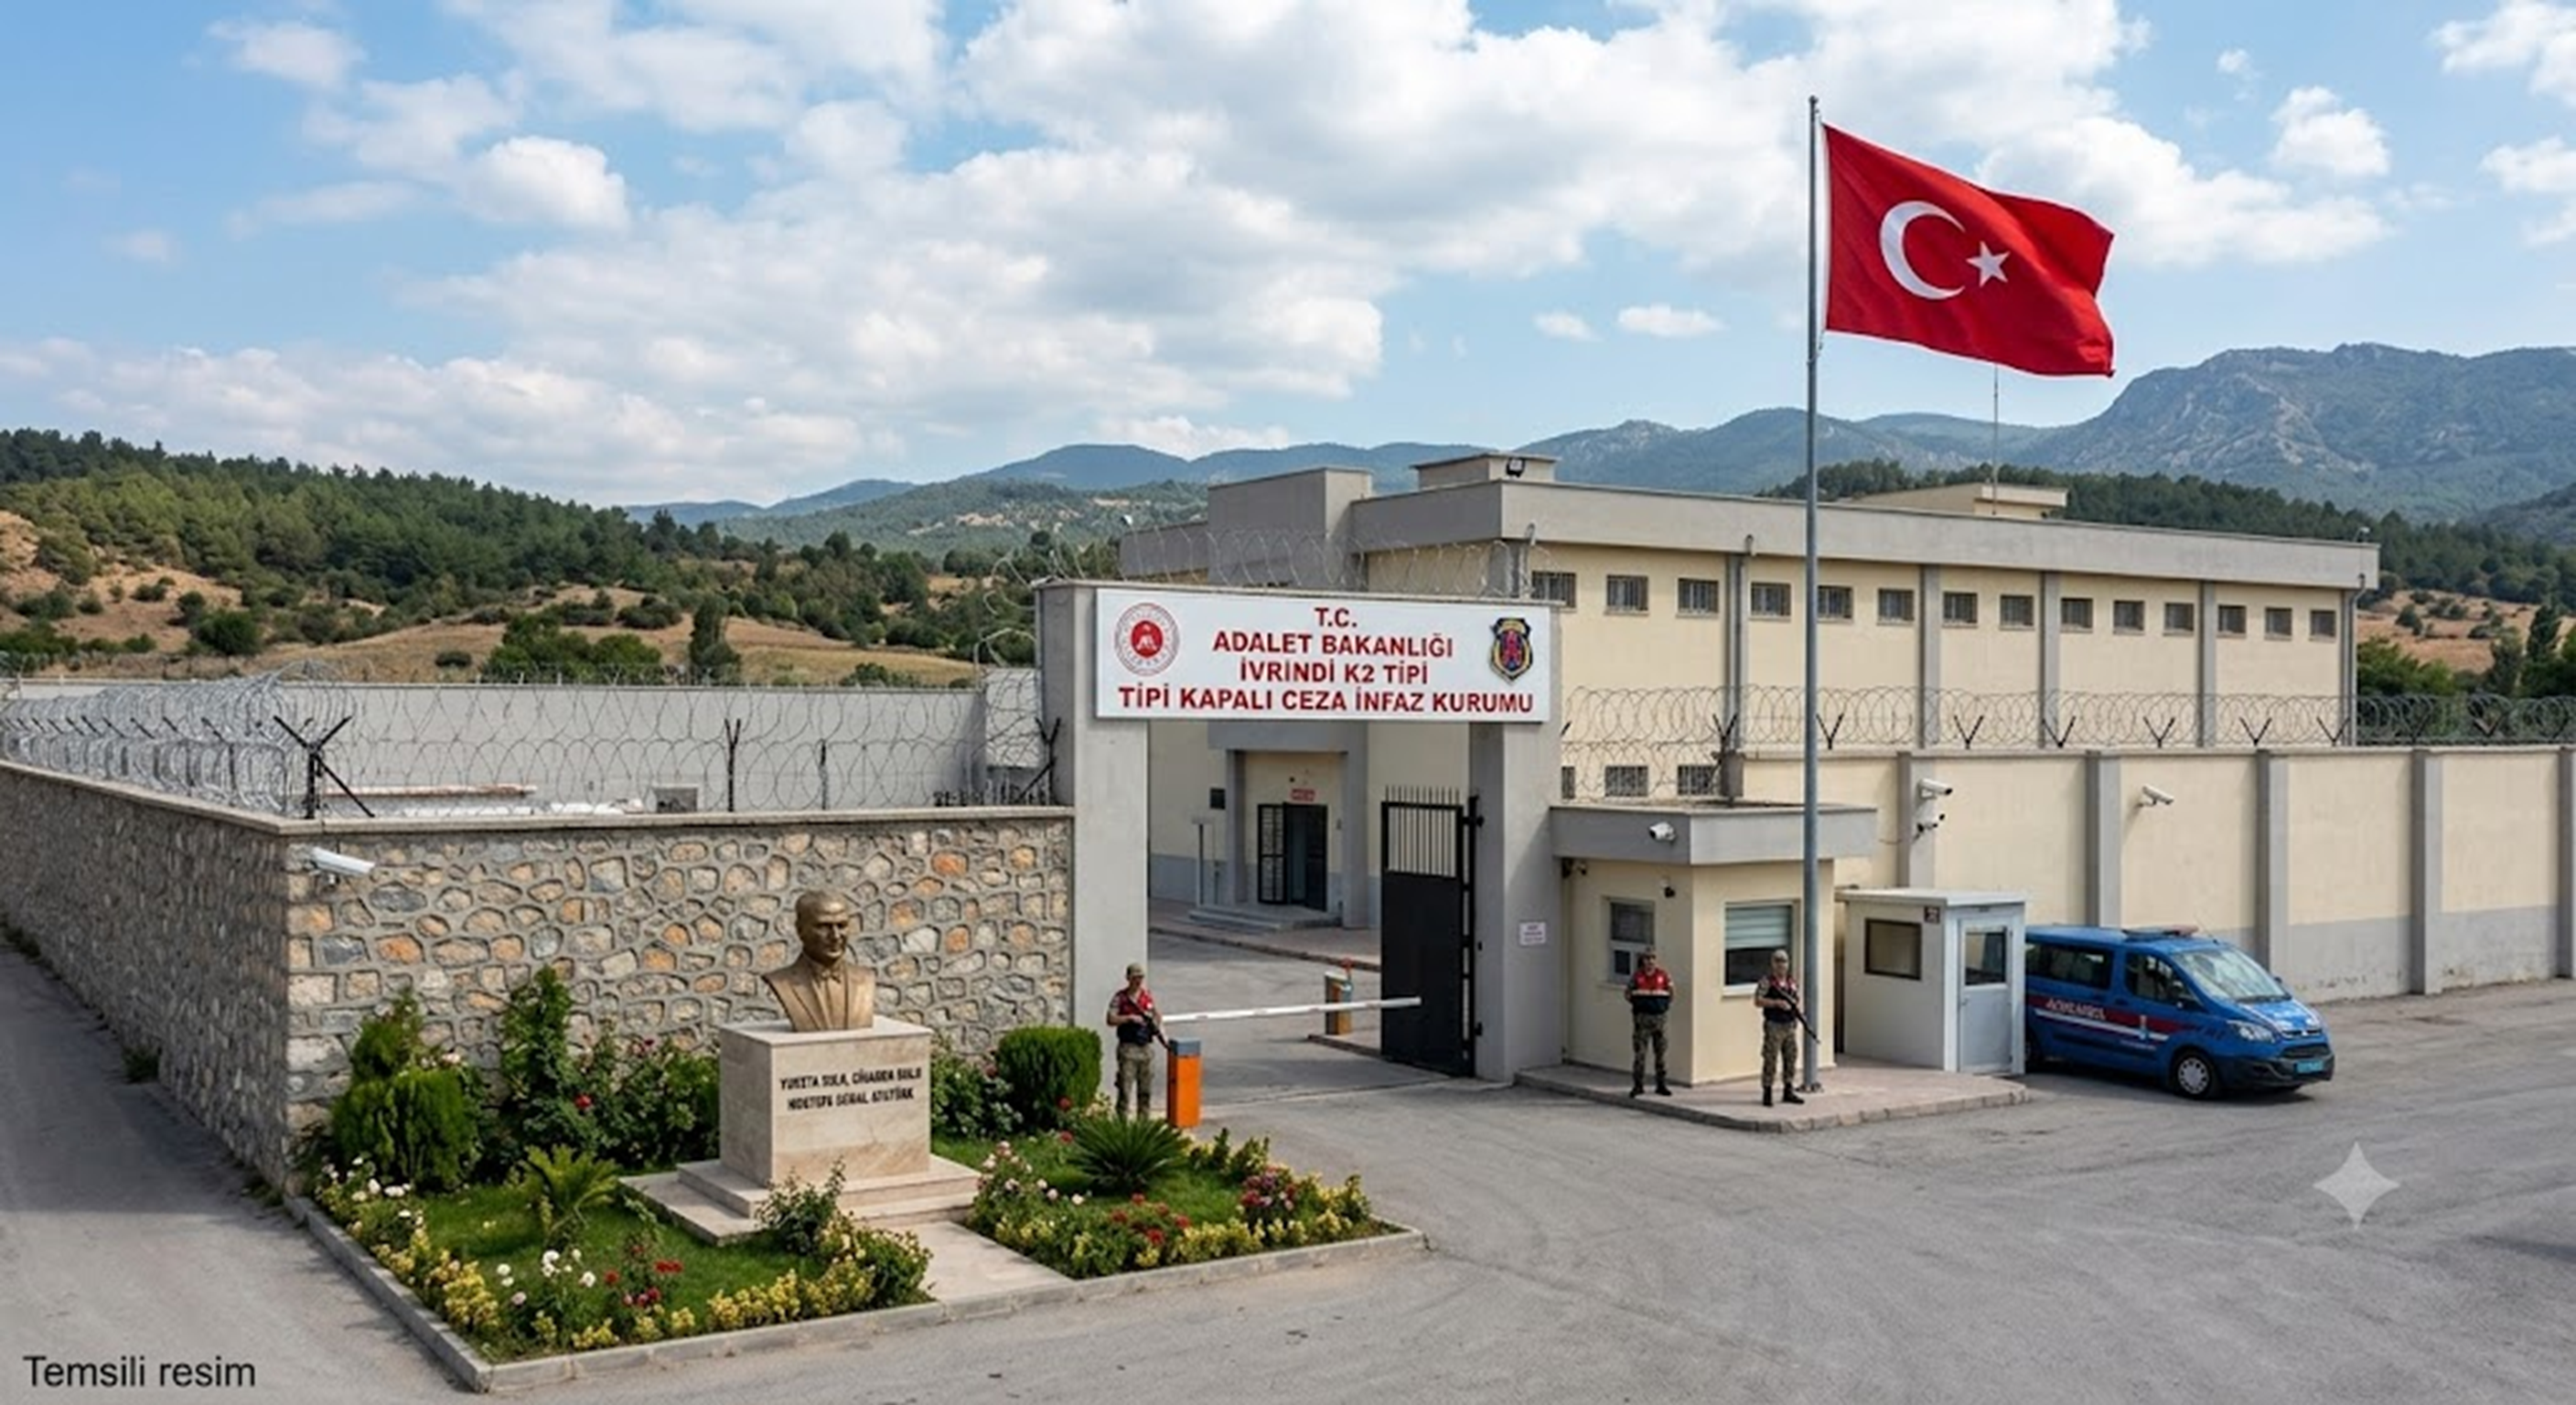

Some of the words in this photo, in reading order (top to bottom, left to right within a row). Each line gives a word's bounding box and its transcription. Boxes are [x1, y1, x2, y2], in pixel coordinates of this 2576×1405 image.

[1314, 607, 1358, 627] T.C.
[1213, 631, 1312, 653] ADALET
[1322, 633, 1452, 657] BAKANLIĞI
[1345, 663, 1375, 683] K2
[1383, 660, 1427, 684] TİPİ
[1119, 682, 1169, 708] TİPİ
[1180, 687, 1272, 711] KAPALI
[1282, 690, 1347, 711] CEZA
[1356, 687, 1424, 712] İNFAZ
[1433, 693, 1533, 713] KURUMU
